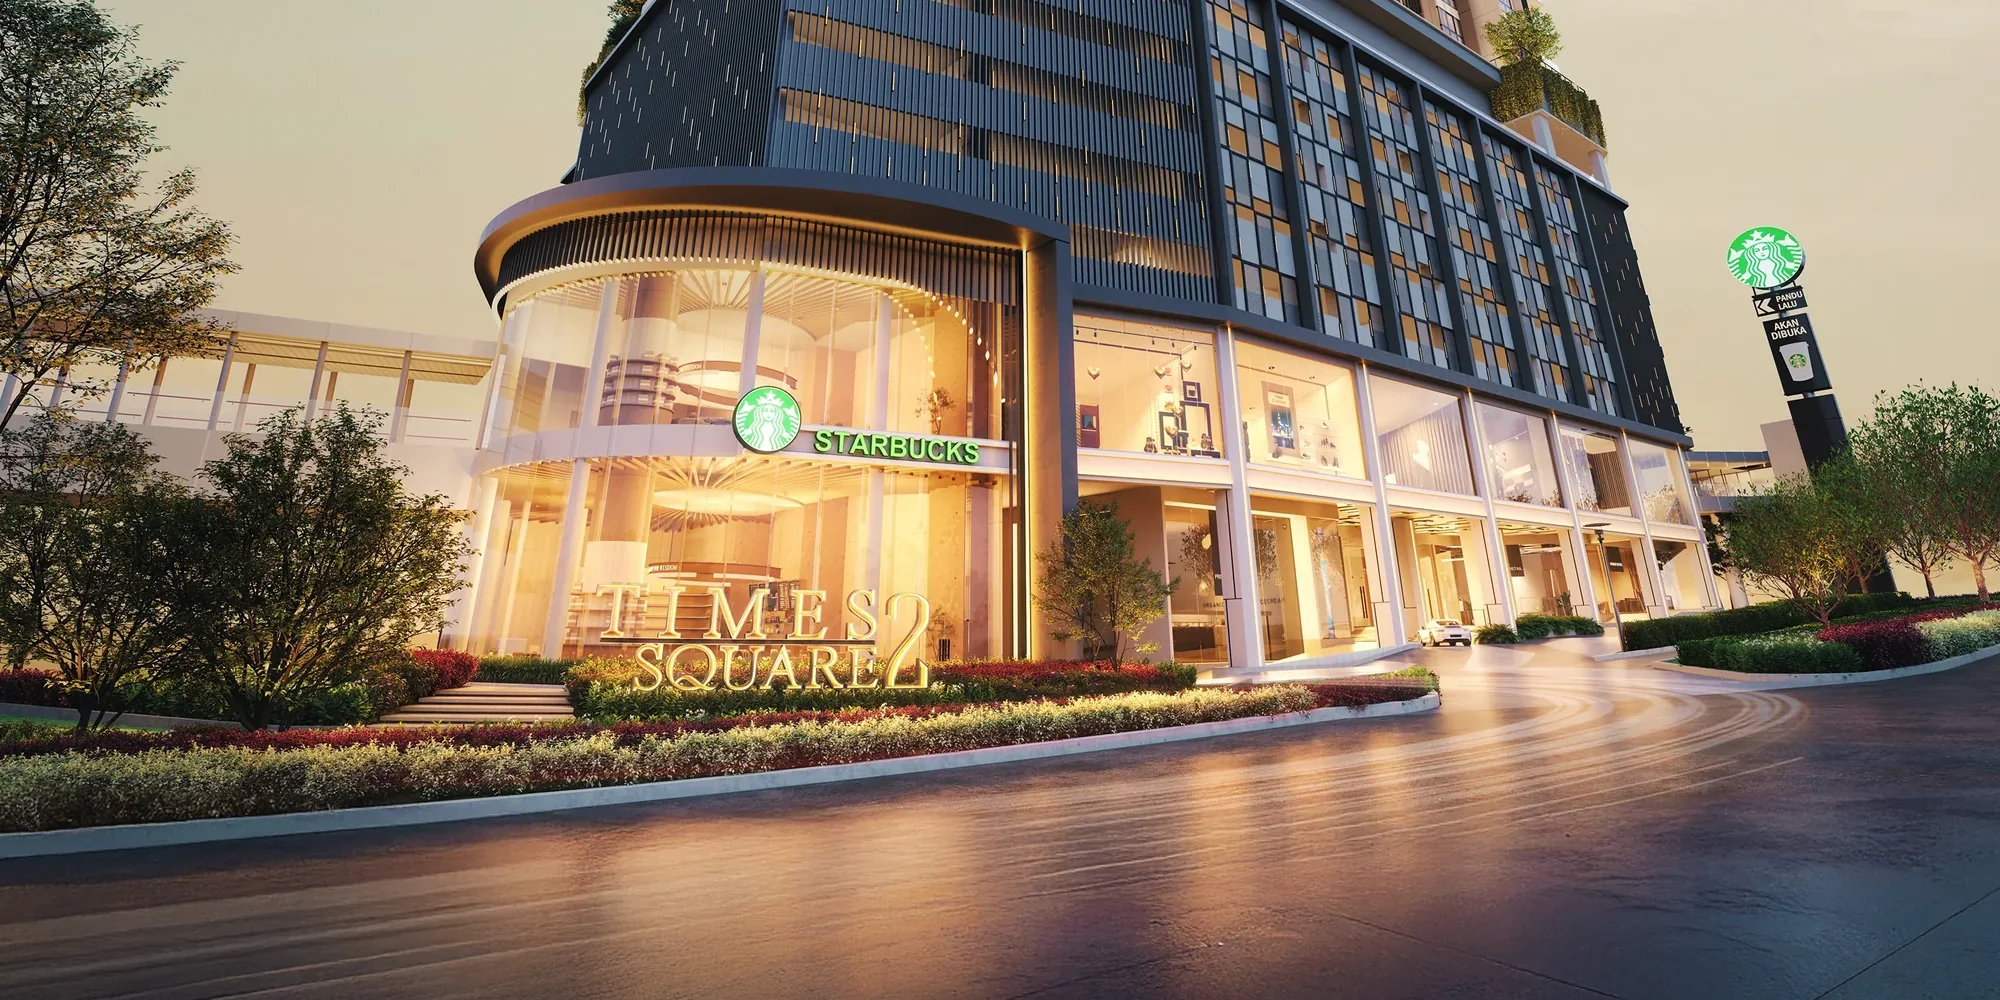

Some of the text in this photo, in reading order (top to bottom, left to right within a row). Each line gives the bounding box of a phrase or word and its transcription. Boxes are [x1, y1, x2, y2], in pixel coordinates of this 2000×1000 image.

[1775, 291, 1803, 303] PANDU
[1778, 300, 1797, 310] LALU
[1771, 326, 1807, 340] DIBUKA
[1774, 318, 1799, 331] AKAN
[814, 429, 980, 464] STARBUCKS
[595, 584, 878, 641] TIMES
[884, 592, 931, 690] 2
[631, 643, 879, 692] SQUARE
